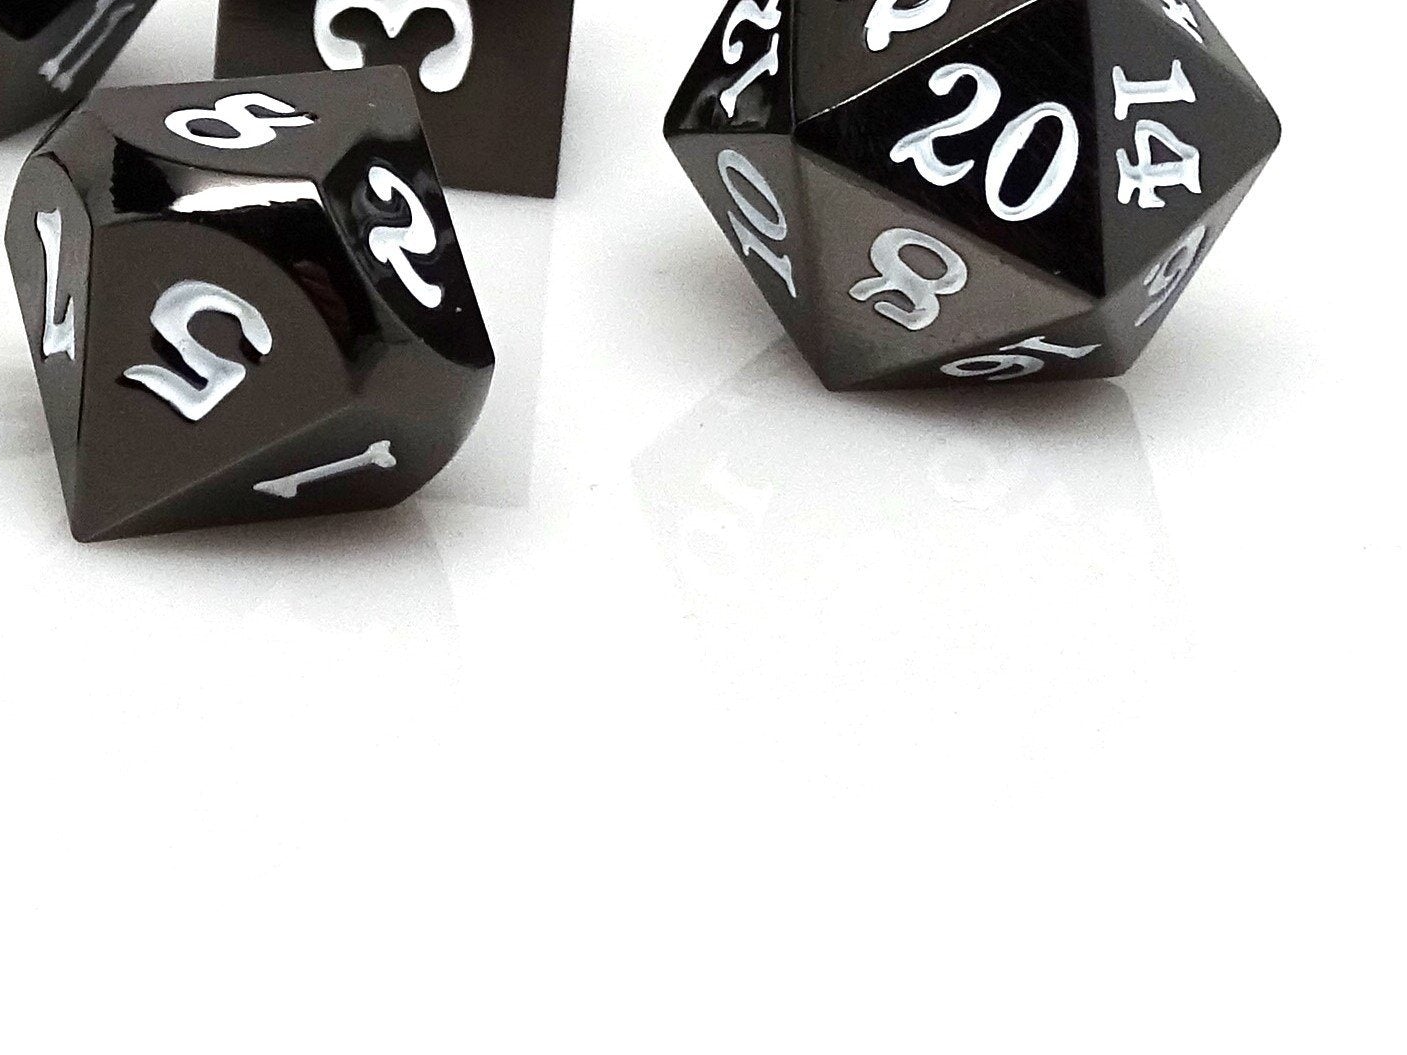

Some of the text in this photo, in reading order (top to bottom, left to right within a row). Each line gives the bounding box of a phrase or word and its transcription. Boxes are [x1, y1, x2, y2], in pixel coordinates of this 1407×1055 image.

[165, 93, 315, 149] 8
[890, 62, 1080, 222] 20
[1112, 59, 1202, 209] 14
[36, 207, 76, 361] 7
[368, 166, 442, 308] 2
[717, 149, 797, 297] 10
[849, 228, 968, 330] 8
[124, 279, 273, 421] 5
[940, 336, 1102, 381] 16
[253, 440, 397, 498] 1
